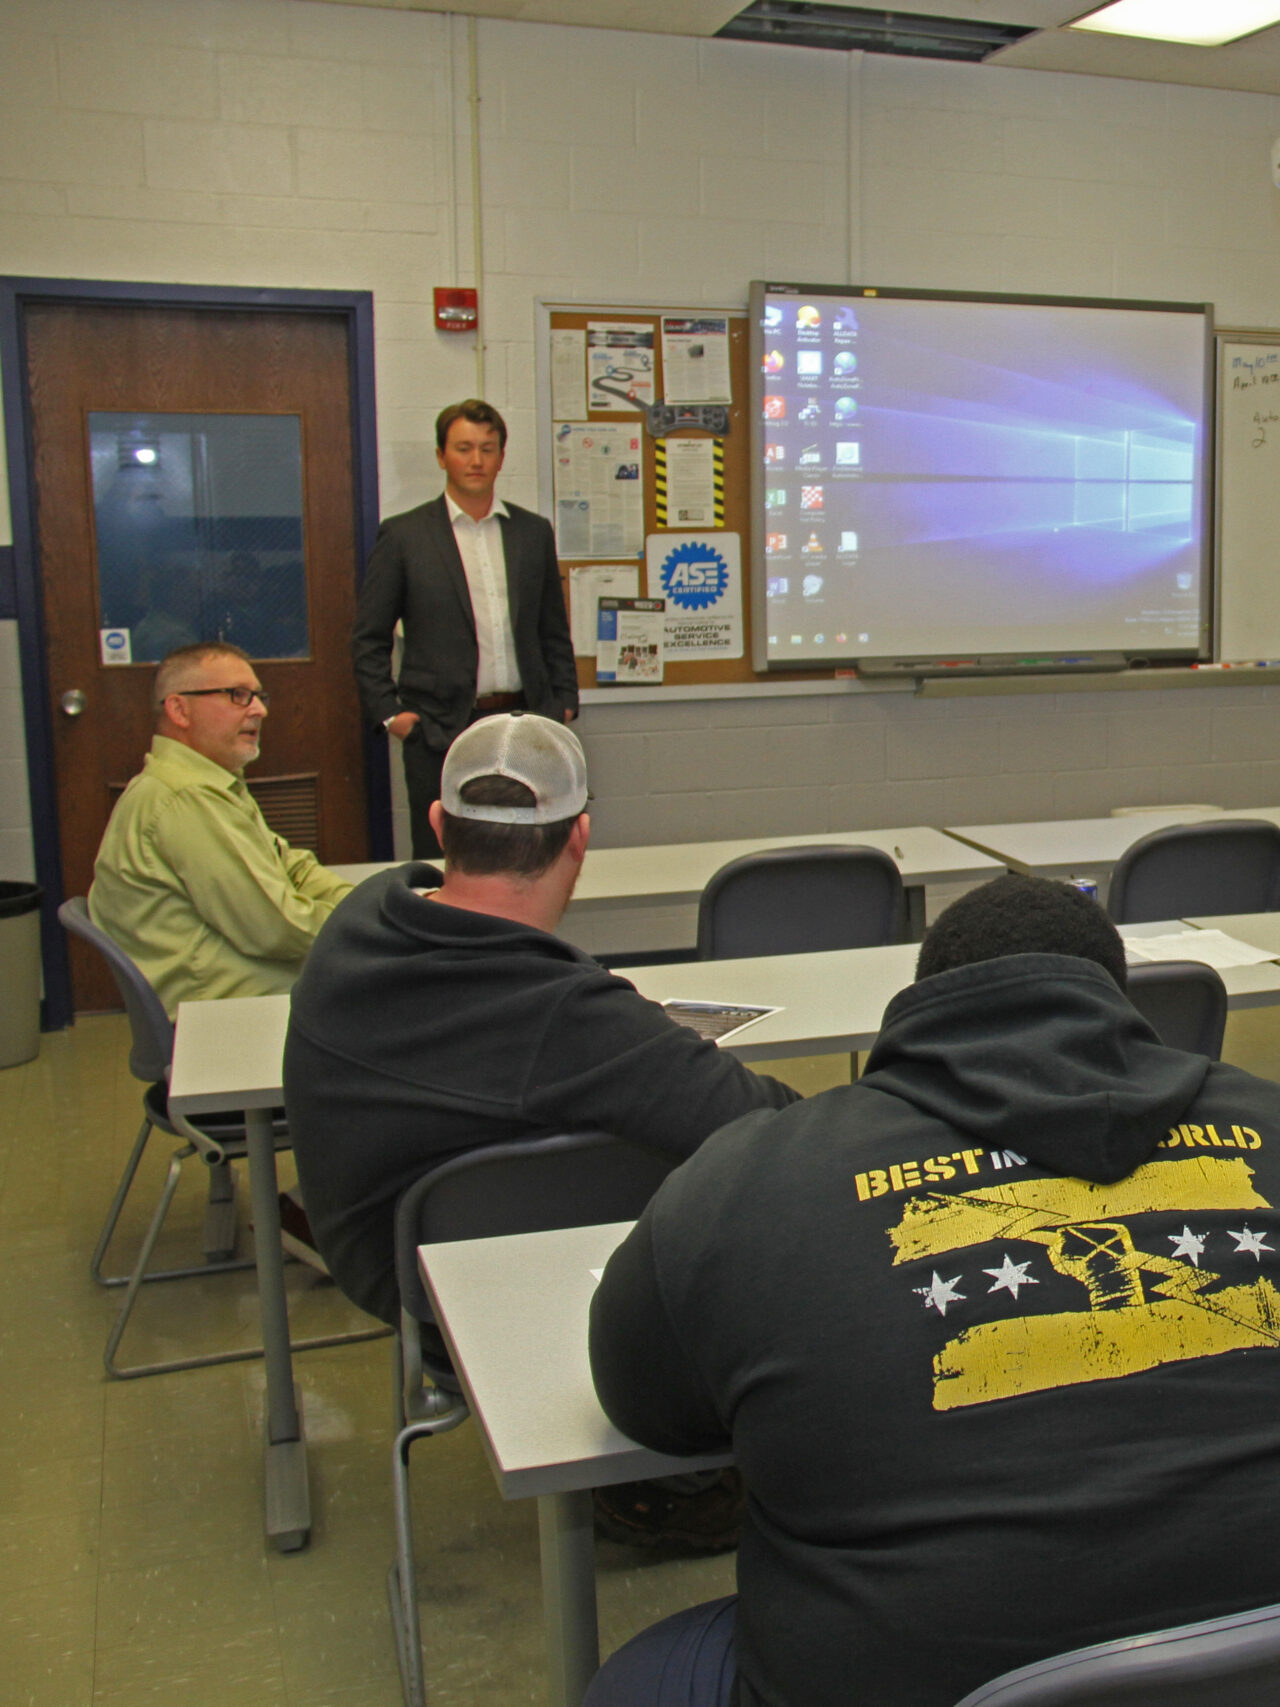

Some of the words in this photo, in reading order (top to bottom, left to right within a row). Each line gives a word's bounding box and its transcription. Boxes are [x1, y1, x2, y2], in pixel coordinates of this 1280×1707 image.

[1252, 427, 1267, 448] 2
[668, 562, 718, 586] ASE
[663, 639, 731, 648] EXCELLENCE
[674, 632, 719, 640] SERVICE
[855, 1148, 984, 1202] BEST
[1157, 1124, 1262, 1150] ORLD
